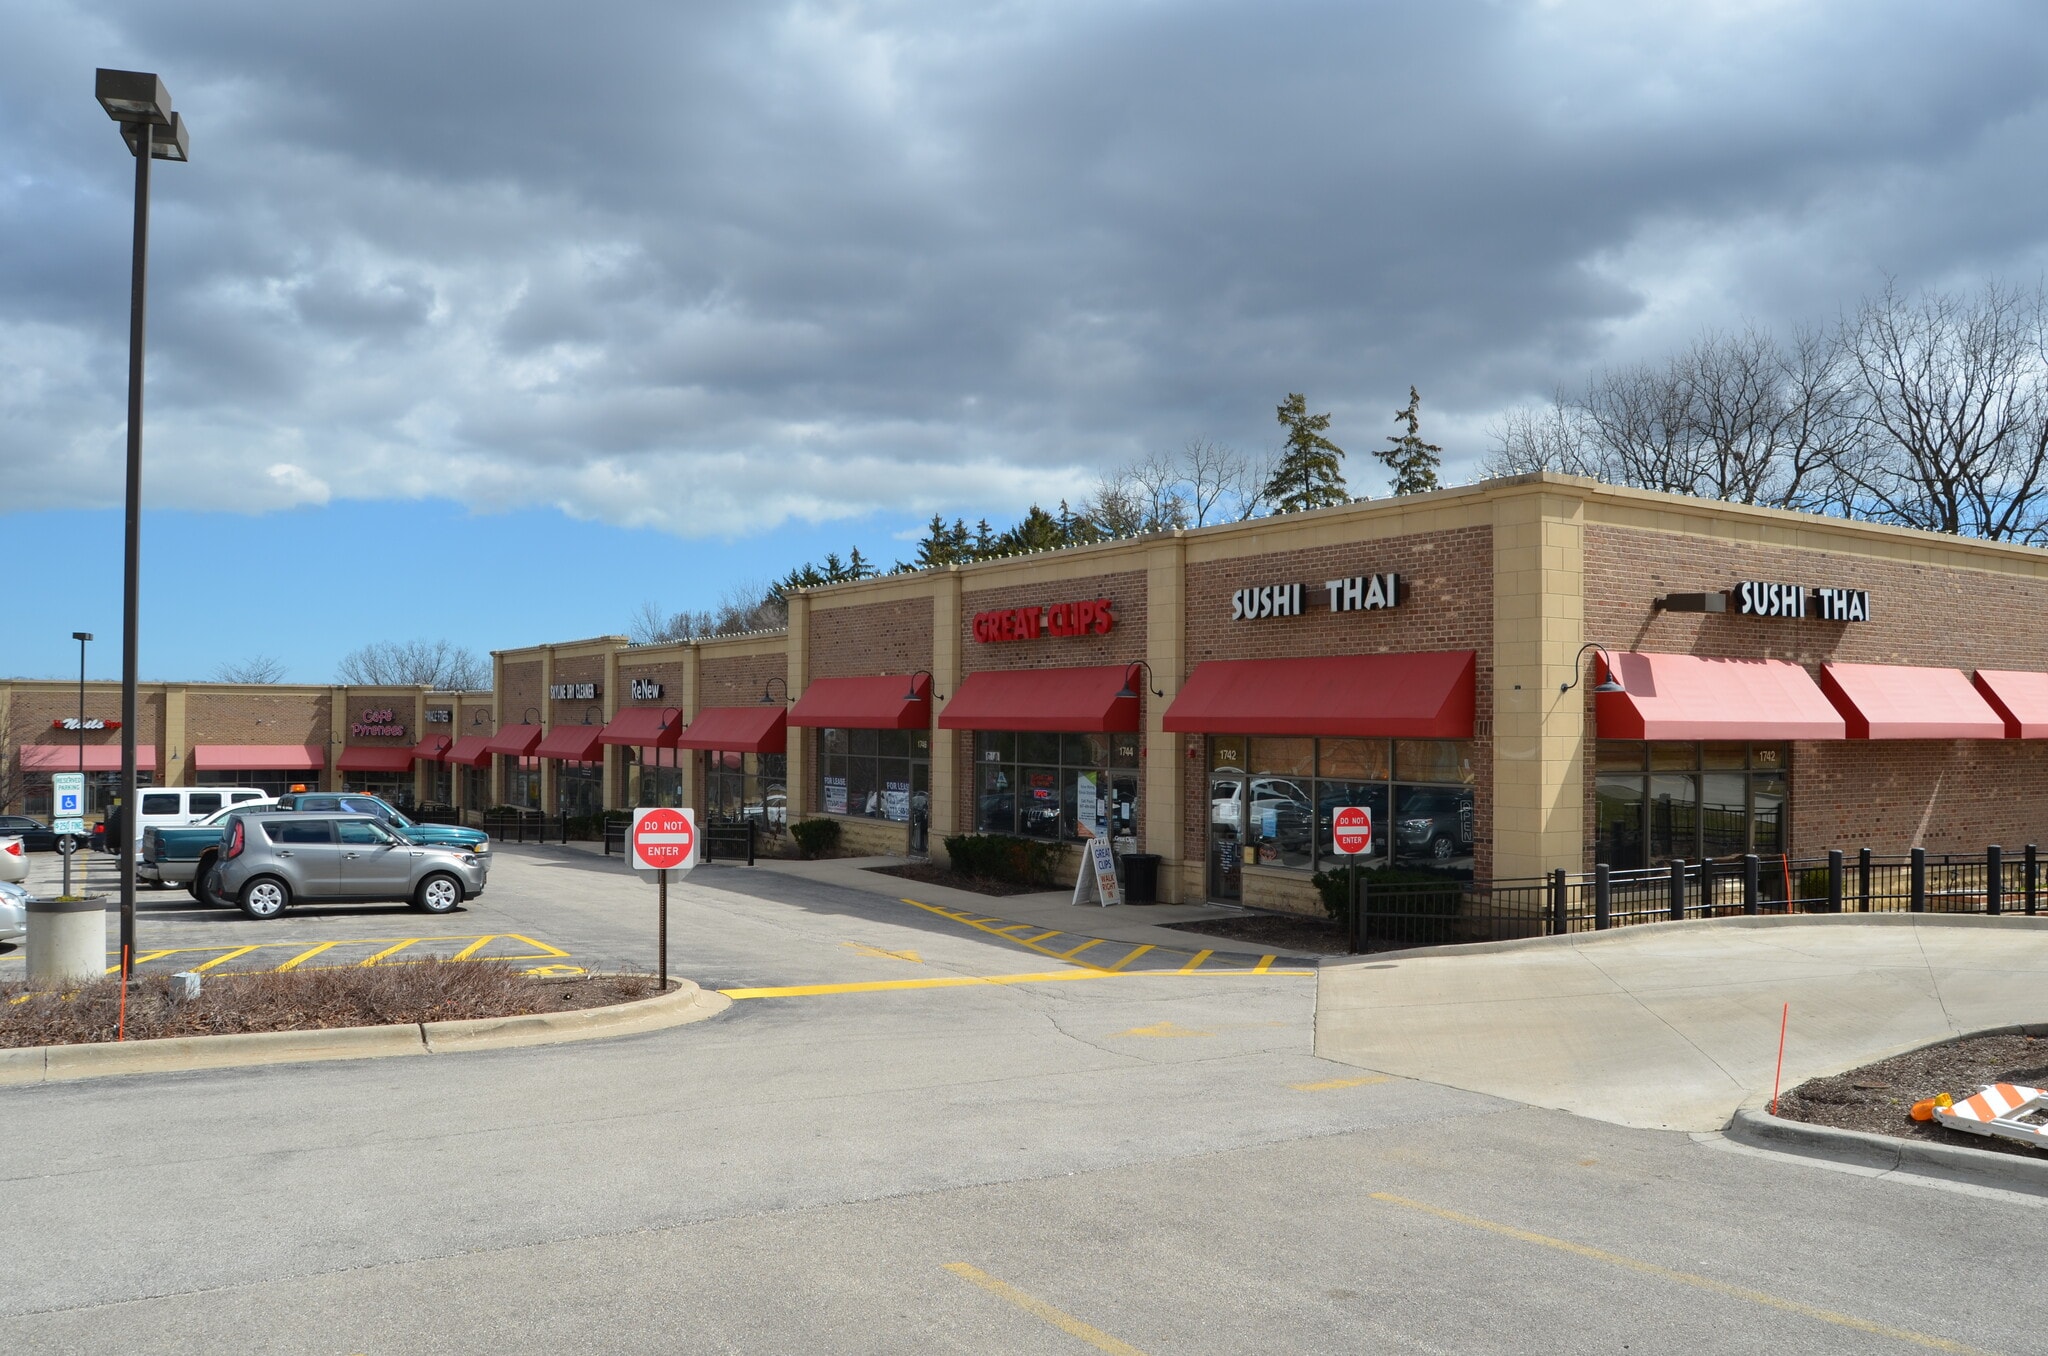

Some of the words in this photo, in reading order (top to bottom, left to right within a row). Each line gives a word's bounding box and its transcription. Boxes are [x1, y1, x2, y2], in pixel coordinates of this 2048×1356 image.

[1232, 583, 1302, 621] SUSHI
[1325, 573, 1397, 612] THAI
[1741, 581, 1806, 618] SUSHI
[1819, 588, 1871, 622] THAI
[973, 607, 1042, 643] GREAT
[1047, 598, 1112, 637] CLIPS
[631, 679, 660, 699] ReNew
[362, 708, 393, 723] Café
[351, 722, 405, 737] Pyrenees
[1119, 746, 1134, 757] 1744
[1220, 750, 1237, 760] 1742
[1760, 750, 1776, 761] 1742
[824, 777, 832, 785] FOR
[833, 777, 846, 786] LEASE
[886, 782, 897, 790] FOR
[644, 821, 658, 831] DO
[663, 821, 683, 831] NOT
[1340, 817, 1349, 825] DO
[1463, 801, 1472, 841] OPEN
[1342, 836, 1362, 844] ENTER
[647, 846, 679, 856] ENTER
[1095, 847, 1111, 859] GREAT
[1098, 859, 1112, 870] CLIPS
[1101, 874, 1114, 882] WALK
[1102, 881, 1115, 891] RIGHT
[1107, 890, 1114, 898] IN
